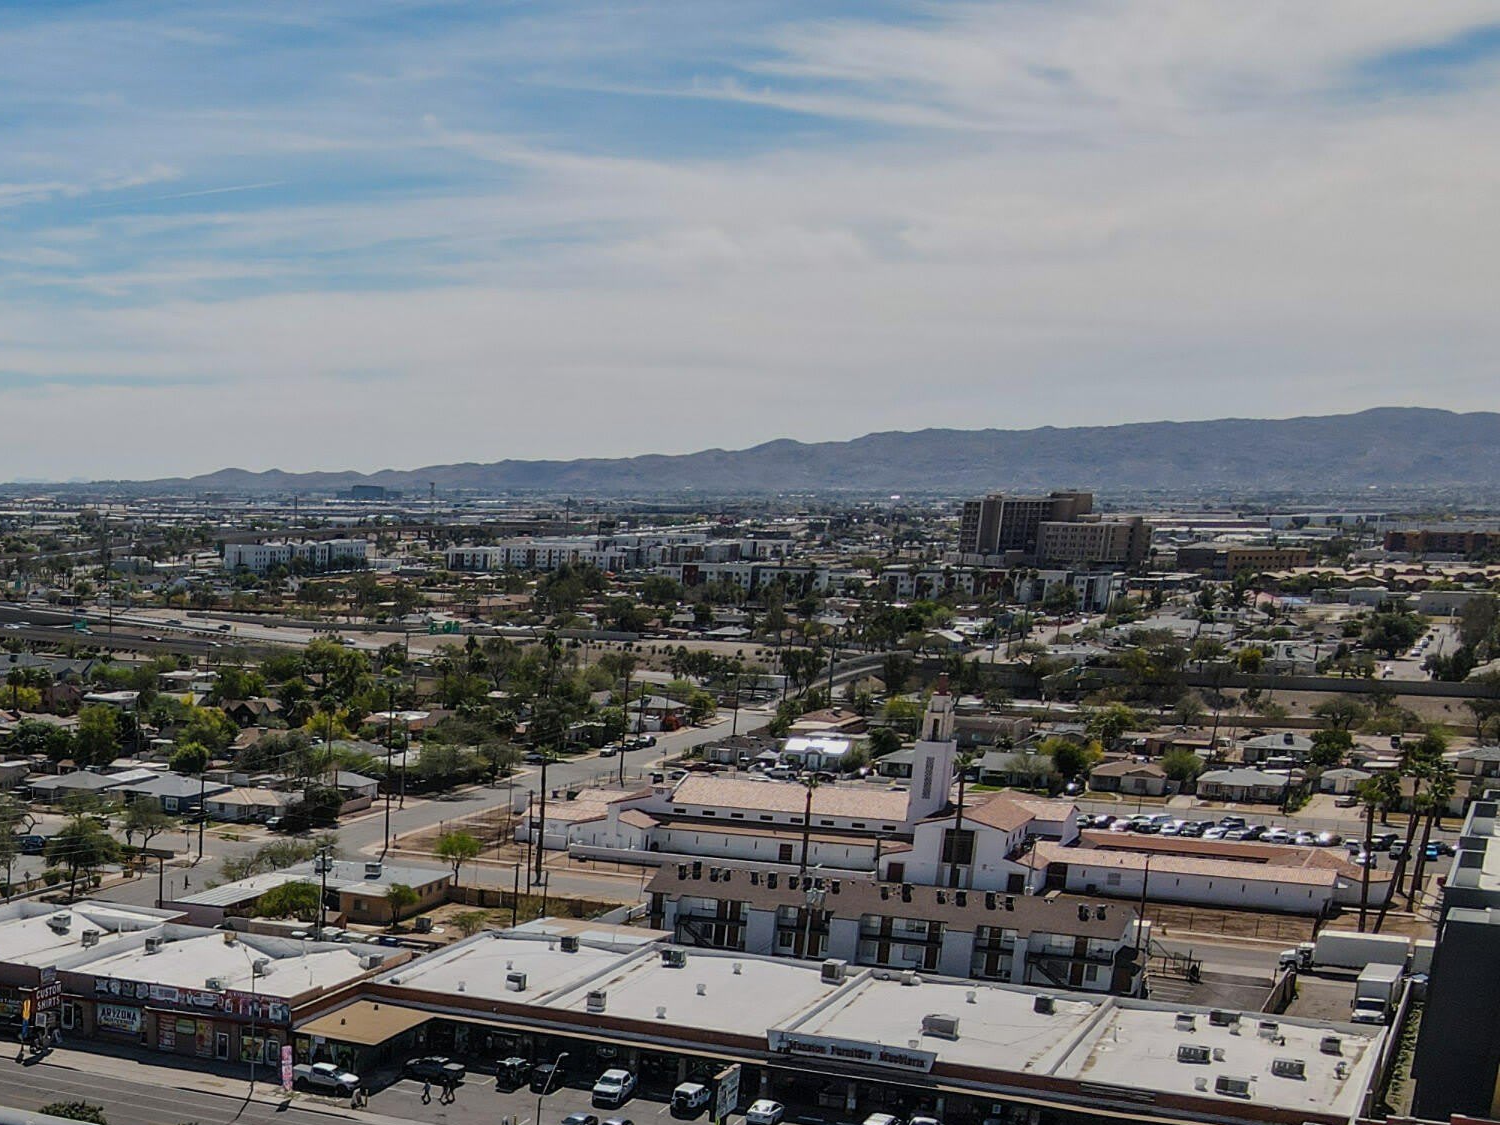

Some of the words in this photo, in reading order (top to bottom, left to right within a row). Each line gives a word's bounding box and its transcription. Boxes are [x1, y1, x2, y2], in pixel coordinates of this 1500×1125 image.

[36, 983, 62, 1000] CUSTOM
[37, 995, 60, 1010] SHIRTS
[101, 1007, 137, 1022] ARIZONA
